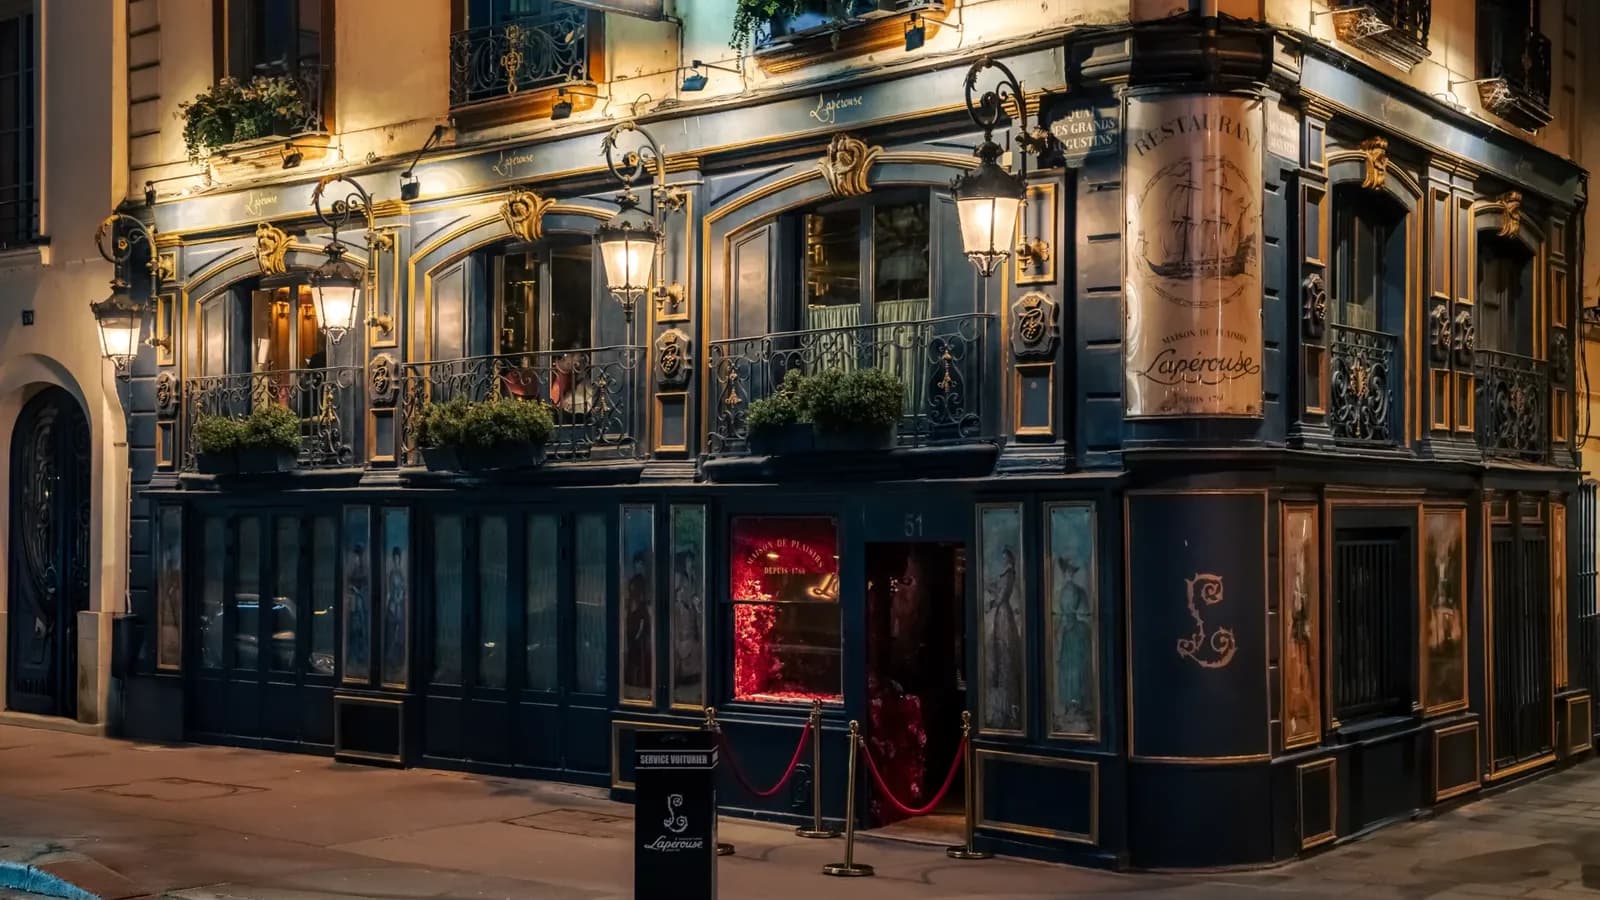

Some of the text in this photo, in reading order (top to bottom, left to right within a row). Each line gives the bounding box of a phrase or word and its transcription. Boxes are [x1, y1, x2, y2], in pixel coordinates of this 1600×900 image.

[1071, 118, 1115, 134] GRANDS
[1136, 348, 1260, 385] Lapérouse
[904, 512, 923, 537] 51
[746, 538, 825, 568] MAISON DE PLAISIRS
[764, 566, 788, 575] DEPUIS
[640, 754, 669, 765] SERVICE
[670, 754, 708, 765] VOITURIER
